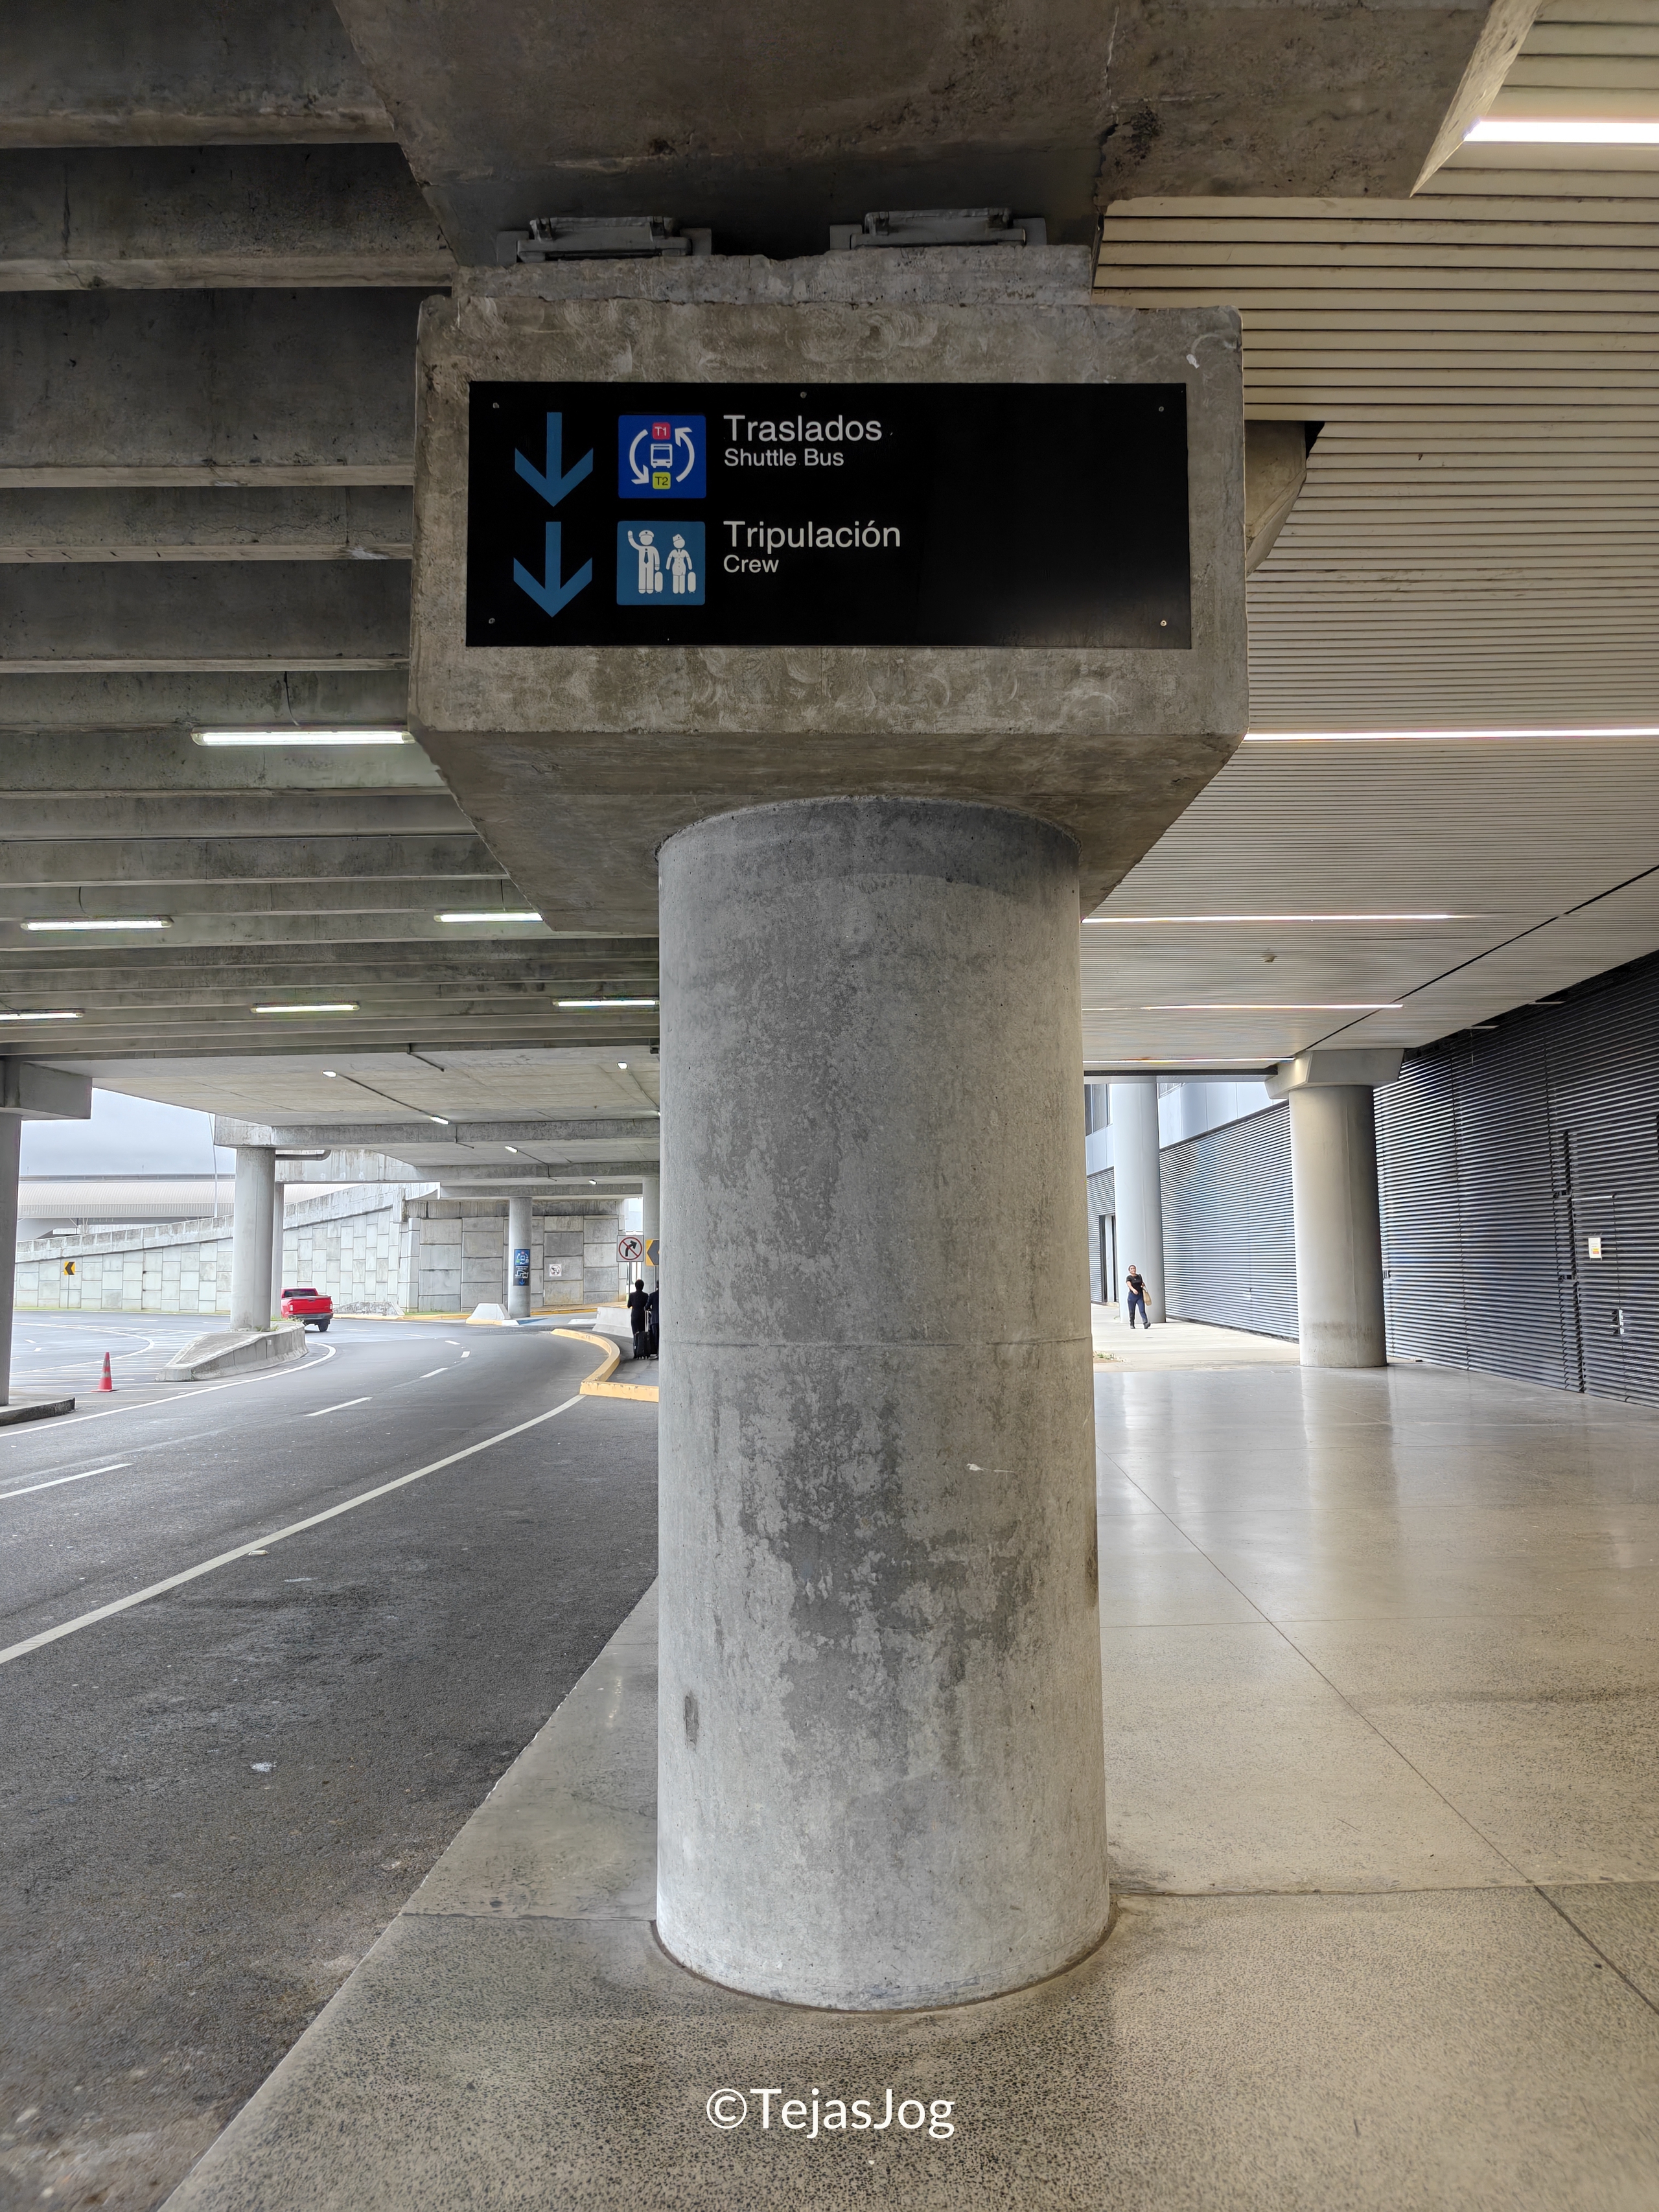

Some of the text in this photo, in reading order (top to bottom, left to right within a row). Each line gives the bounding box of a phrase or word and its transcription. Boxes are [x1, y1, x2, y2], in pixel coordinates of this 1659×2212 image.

[654, 426, 667, 437] T1
[723, 415, 882, 441] Traslados
[725, 448, 844, 467] Shuttle Bus
[655, 476, 669, 486] T2
[723, 520, 900, 555] Tripulación
[723, 554, 779, 573] Crew
